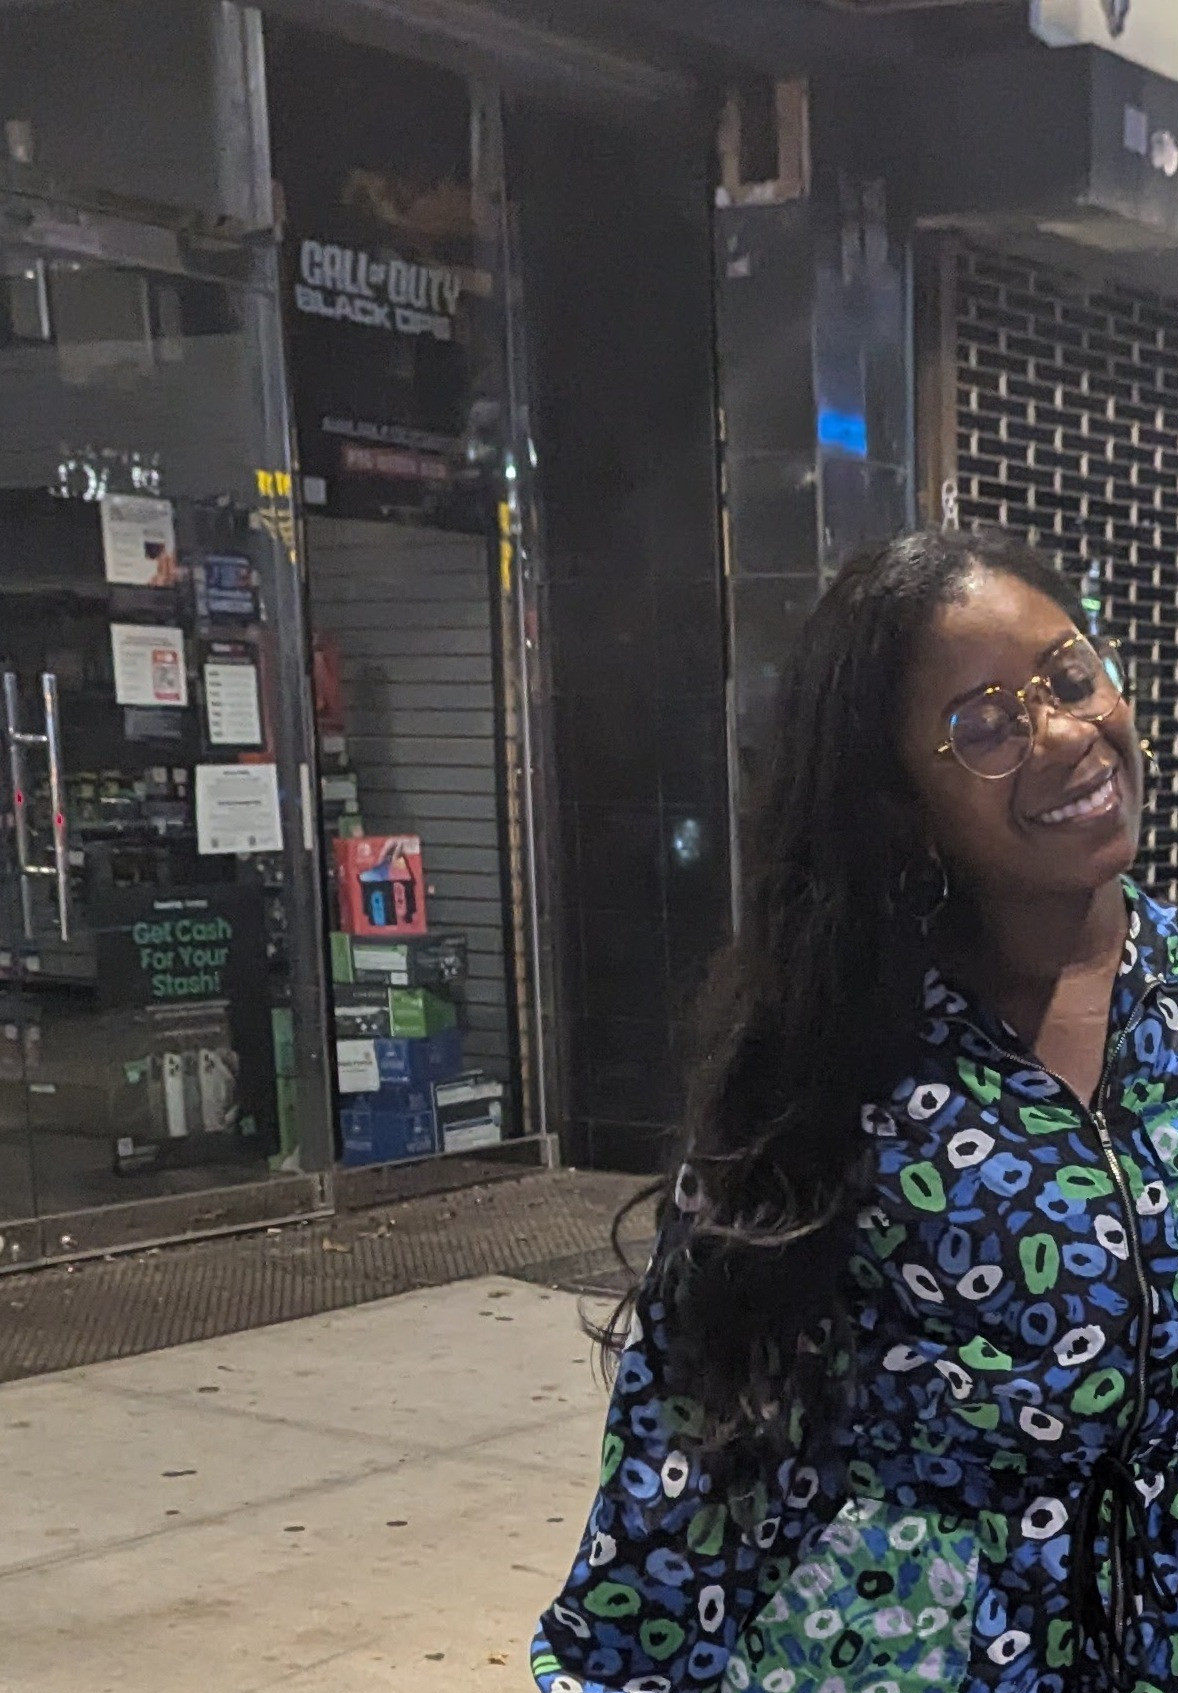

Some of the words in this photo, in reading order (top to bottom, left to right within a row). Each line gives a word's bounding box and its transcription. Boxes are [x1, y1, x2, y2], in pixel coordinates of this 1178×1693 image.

[301, 239, 373, 298] CALL
[388, 259, 461, 316] DUTY
[295, 283, 392, 330] BLACK
[133, 920, 173, 944] Get
[175, 917, 232, 943] Cash
[141, 947, 174, 970] For
[178, 946, 229, 968] Your
